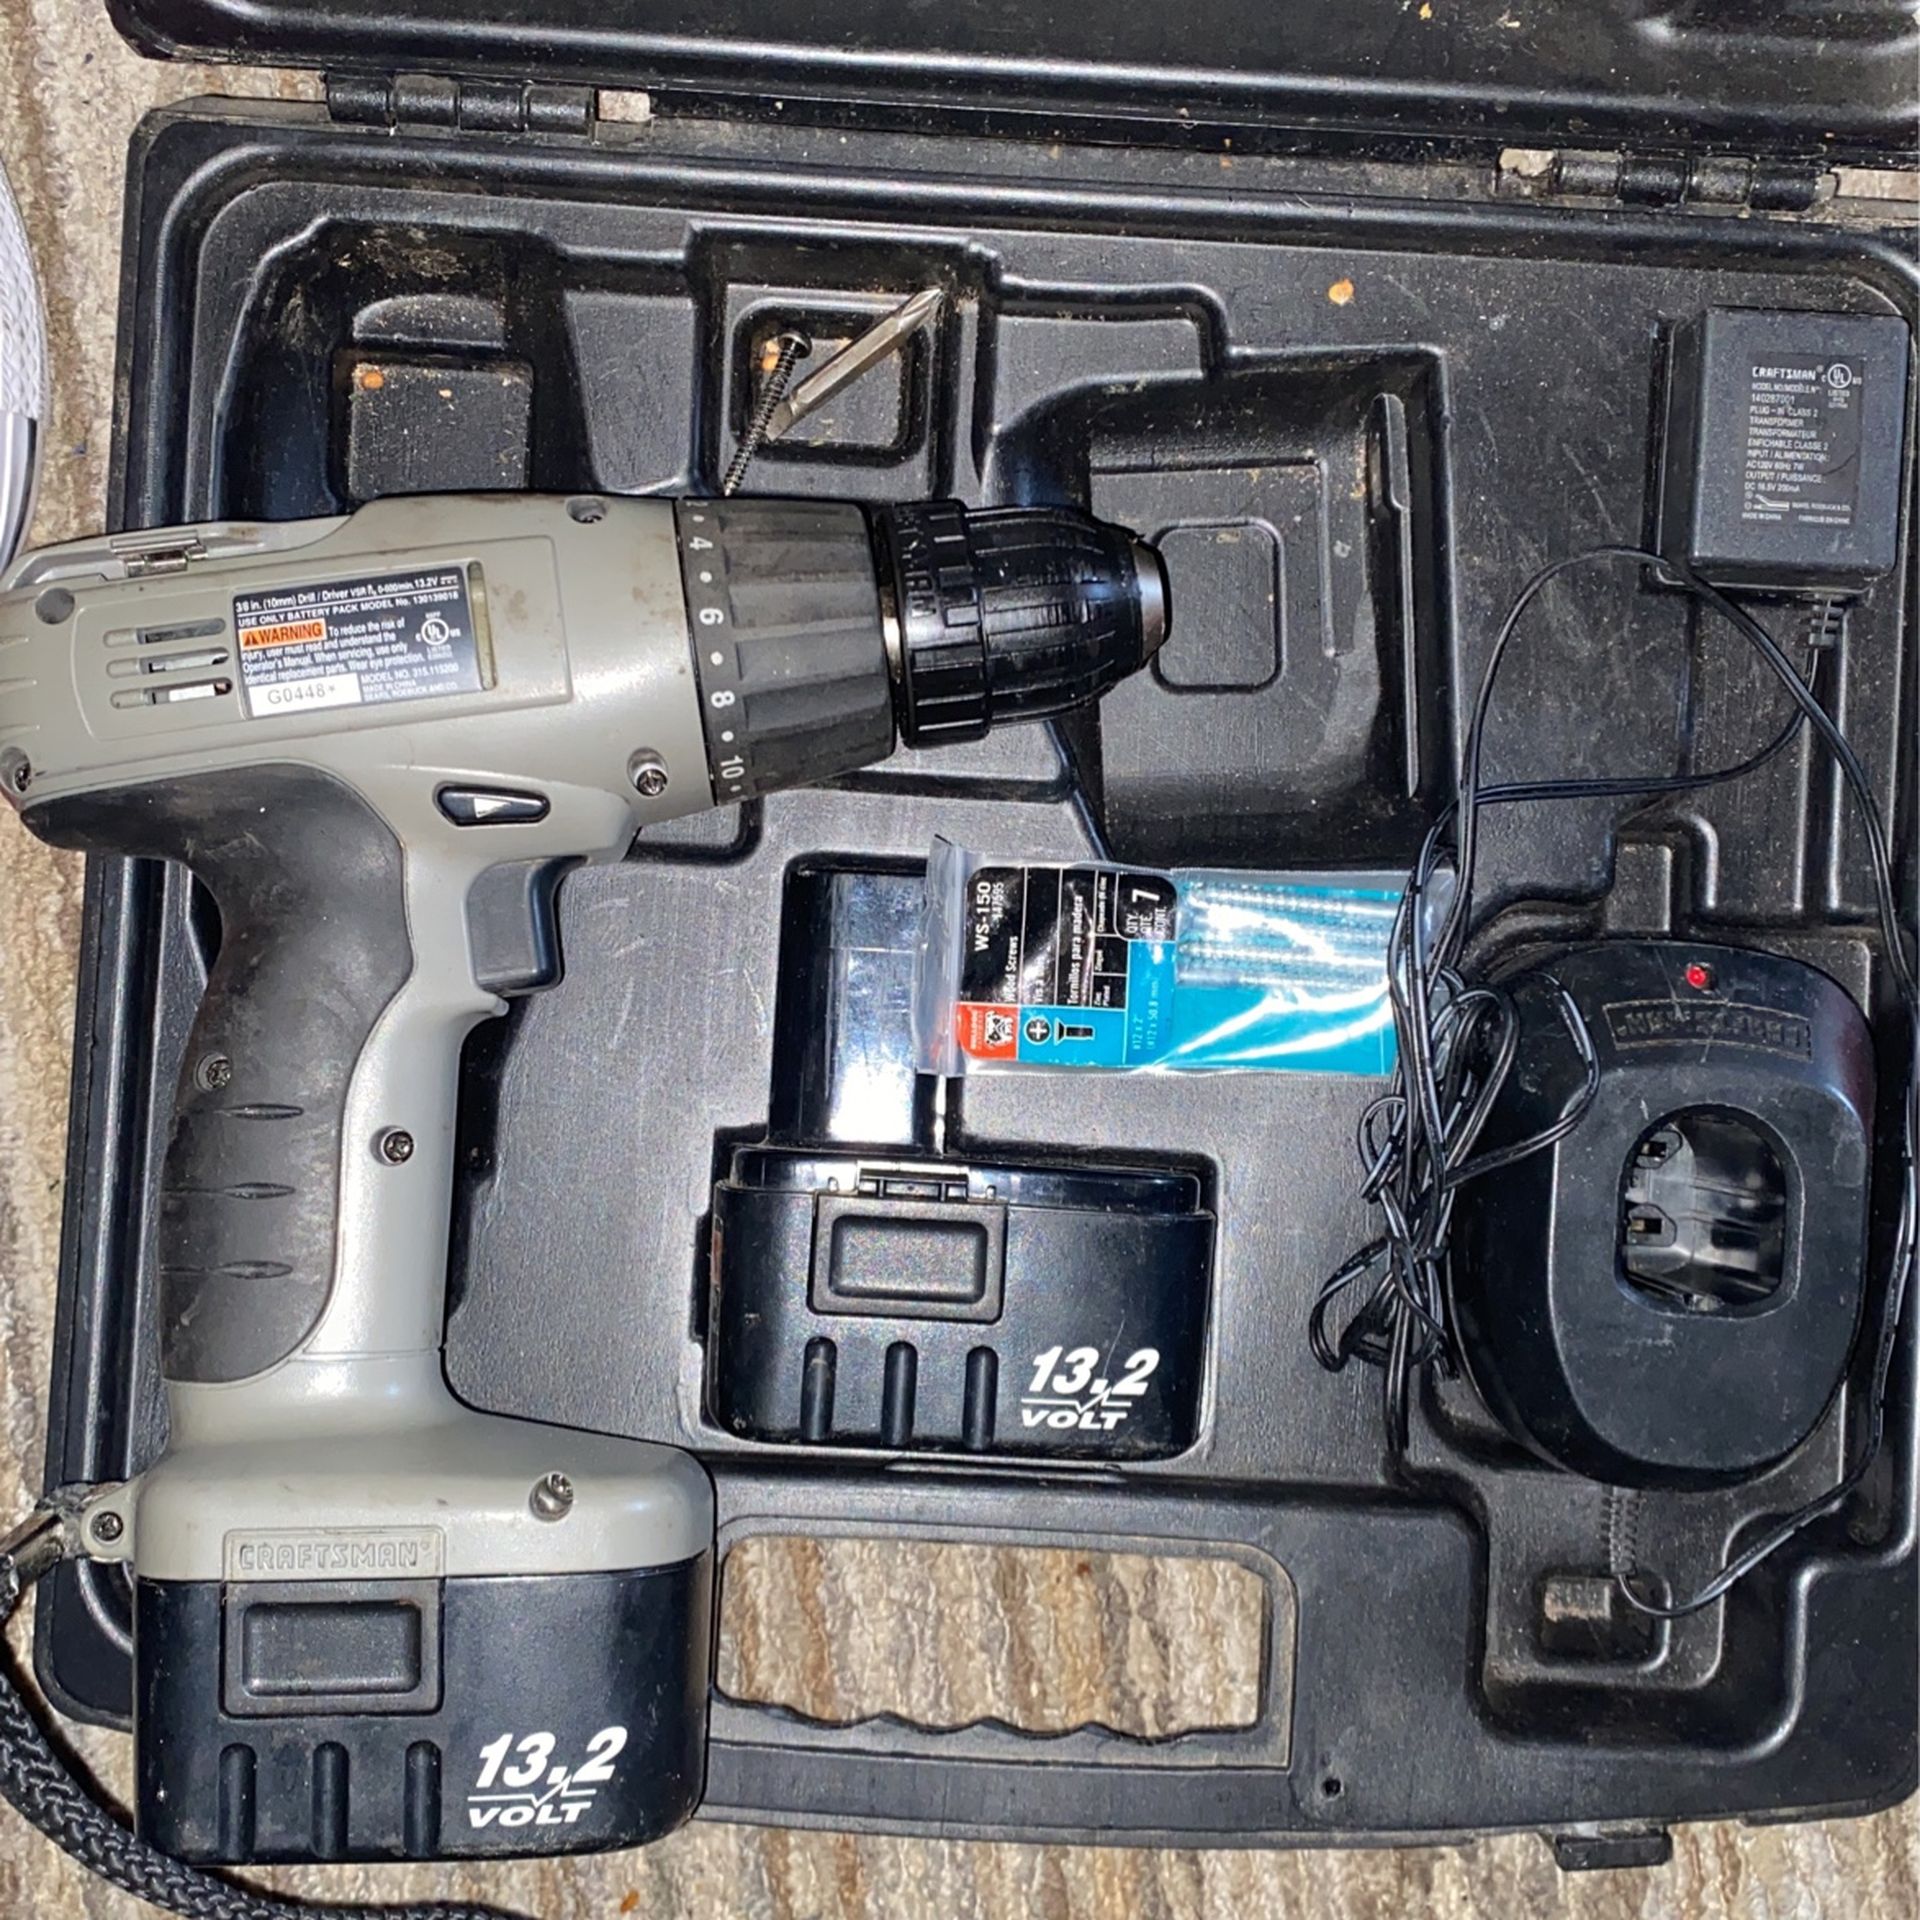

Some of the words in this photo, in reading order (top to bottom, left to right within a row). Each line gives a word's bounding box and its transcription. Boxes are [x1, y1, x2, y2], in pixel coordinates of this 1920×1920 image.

[1752, 366, 1816, 380] CRAFTSMAN
[1749, 416, 1804, 427] TRANSFORMER
[1750, 406, 1770, 415] PLUG
[1788, 407, 1812, 417] CLASS
[1813, 408, 1819, 417] 2
[1749, 428, 1818, 438] TRANSFORMATEUR
[1747, 438, 1792, 449] ENFICHABLE
[1794, 440, 1821, 450] CLASSE
[1822, 441, 1829, 451] 2
[1747, 450, 1769, 459] INPUT
[1744, 481, 1756, 490] DC
[1745, 471, 1775, 480] OUTPUT
[689, 536, 713, 550] 4
[263, 595, 297, 611] (10mm)
[297, 591, 316, 604] Drill
[322, 588, 348, 601] Driver
[238, 615, 257, 627] USE
[260, 611, 285, 624] ONLY
[287, 606, 330, 621] BATTERY
[332, 603, 359, 615] PACK
[361, 599, 394, 612] MODEL
[396, 597, 411, 608] No.
[699, 607, 724, 626] 6
[259, 622, 322, 644] WARNING
[328, 626, 339, 637] To
[340, 624, 366, 636] reduce
[367, 621, 380, 632] the
[381, 619, 396, 630] risk
[396, 616, 405, 629] of
[265, 647, 283, 658] user
[284, 644, 304, 655] must
[305, 641, 322, 652] read
[323, 638, 340, 650] and
[339, 632, 382, 648] understand
[383, 631, 397, 642] the
[243, 658, 282, 674] Operator's
[314, 651, 337, 663] When
[375, 645, 390, 656] use
[391, 641, 408, 655] only
[278, 664, 324, 682] replacement
[348, 659, 369, 671] Wear
[369, 659, 384, 671] eye
[361, 671, 393, 684] MODEL
[711, 690, 736, 709] 8
[720, 755, 745, 780] 10
[1131, 889, 1161, 903] 7
[974, 881, 992, 952] WS-150
[1073, 895, 1084, 933] madera
[1126, 912, 1139, 934] QTY.
[1154, 906, 1168, 936] CONT.
[1005, 936, 1019, 972] Screws
[1071, 935, 1085, 961] para
[1067, 961, 1081, 1004] Tornillos
[1029, 1346, 1160, 1395] 13.2
[1021, 1409, 1128, 1430] VOLT
[239, 1542, 418, 1570] CRAFTSMAN
[475, 1726, 628, 1788] 13.2
[468, 1802, 592, 1828] VOLT
